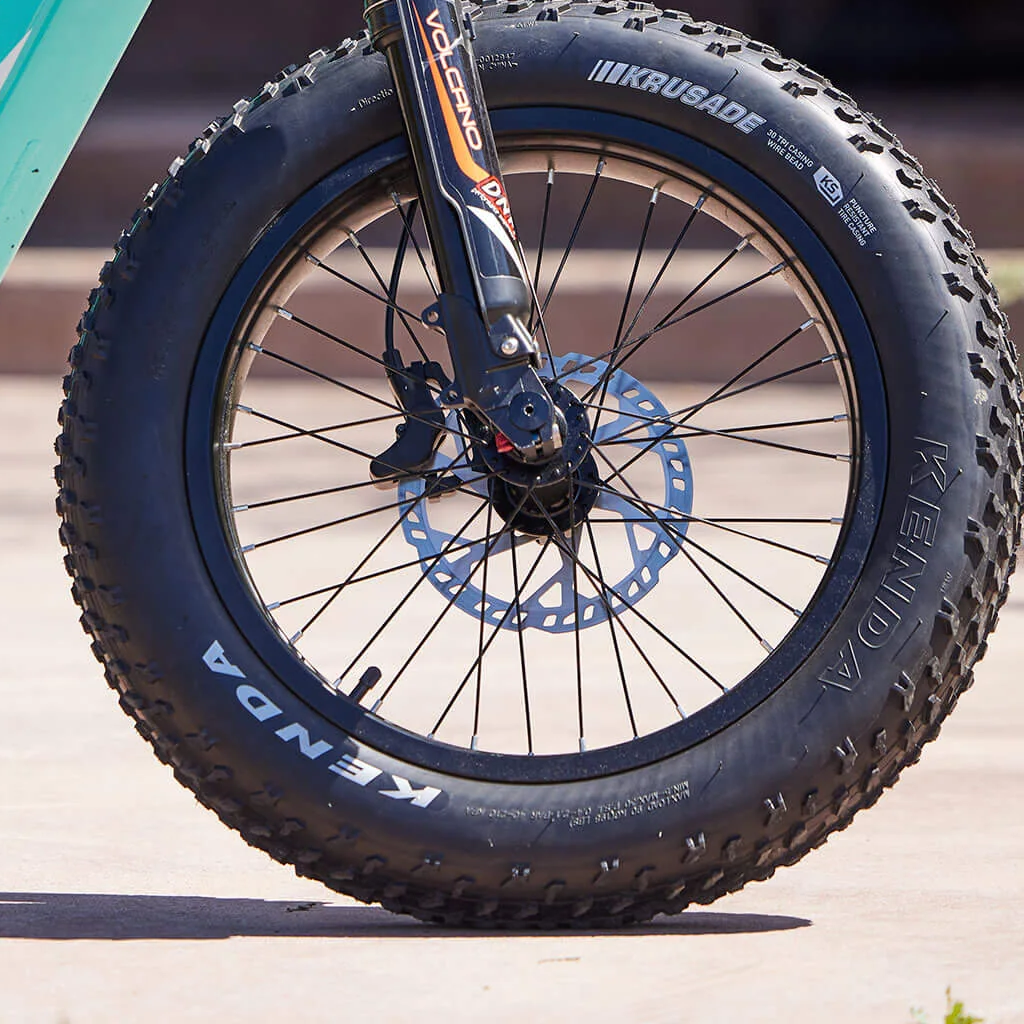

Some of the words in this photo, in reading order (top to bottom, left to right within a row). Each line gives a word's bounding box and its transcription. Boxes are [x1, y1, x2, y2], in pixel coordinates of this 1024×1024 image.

[426, 8, 483, 152] VOLCANO
[618, 64, 768, 135] KRUSADE
[767, 139, 785, 156] WIRE
[784, 152, 804, 171] BEAD
[788, 144, 814, 168] CASING
[837, 208, 849, 224] TIRE
[847, 221, 866, 247] CASING
[843, 203, 871, 238] RESISTANT
[849, 198, 877, 234] PUNCTURE
[818, 436, 949, 692] KENDA
[202, 639, 443, 809] KENDA
